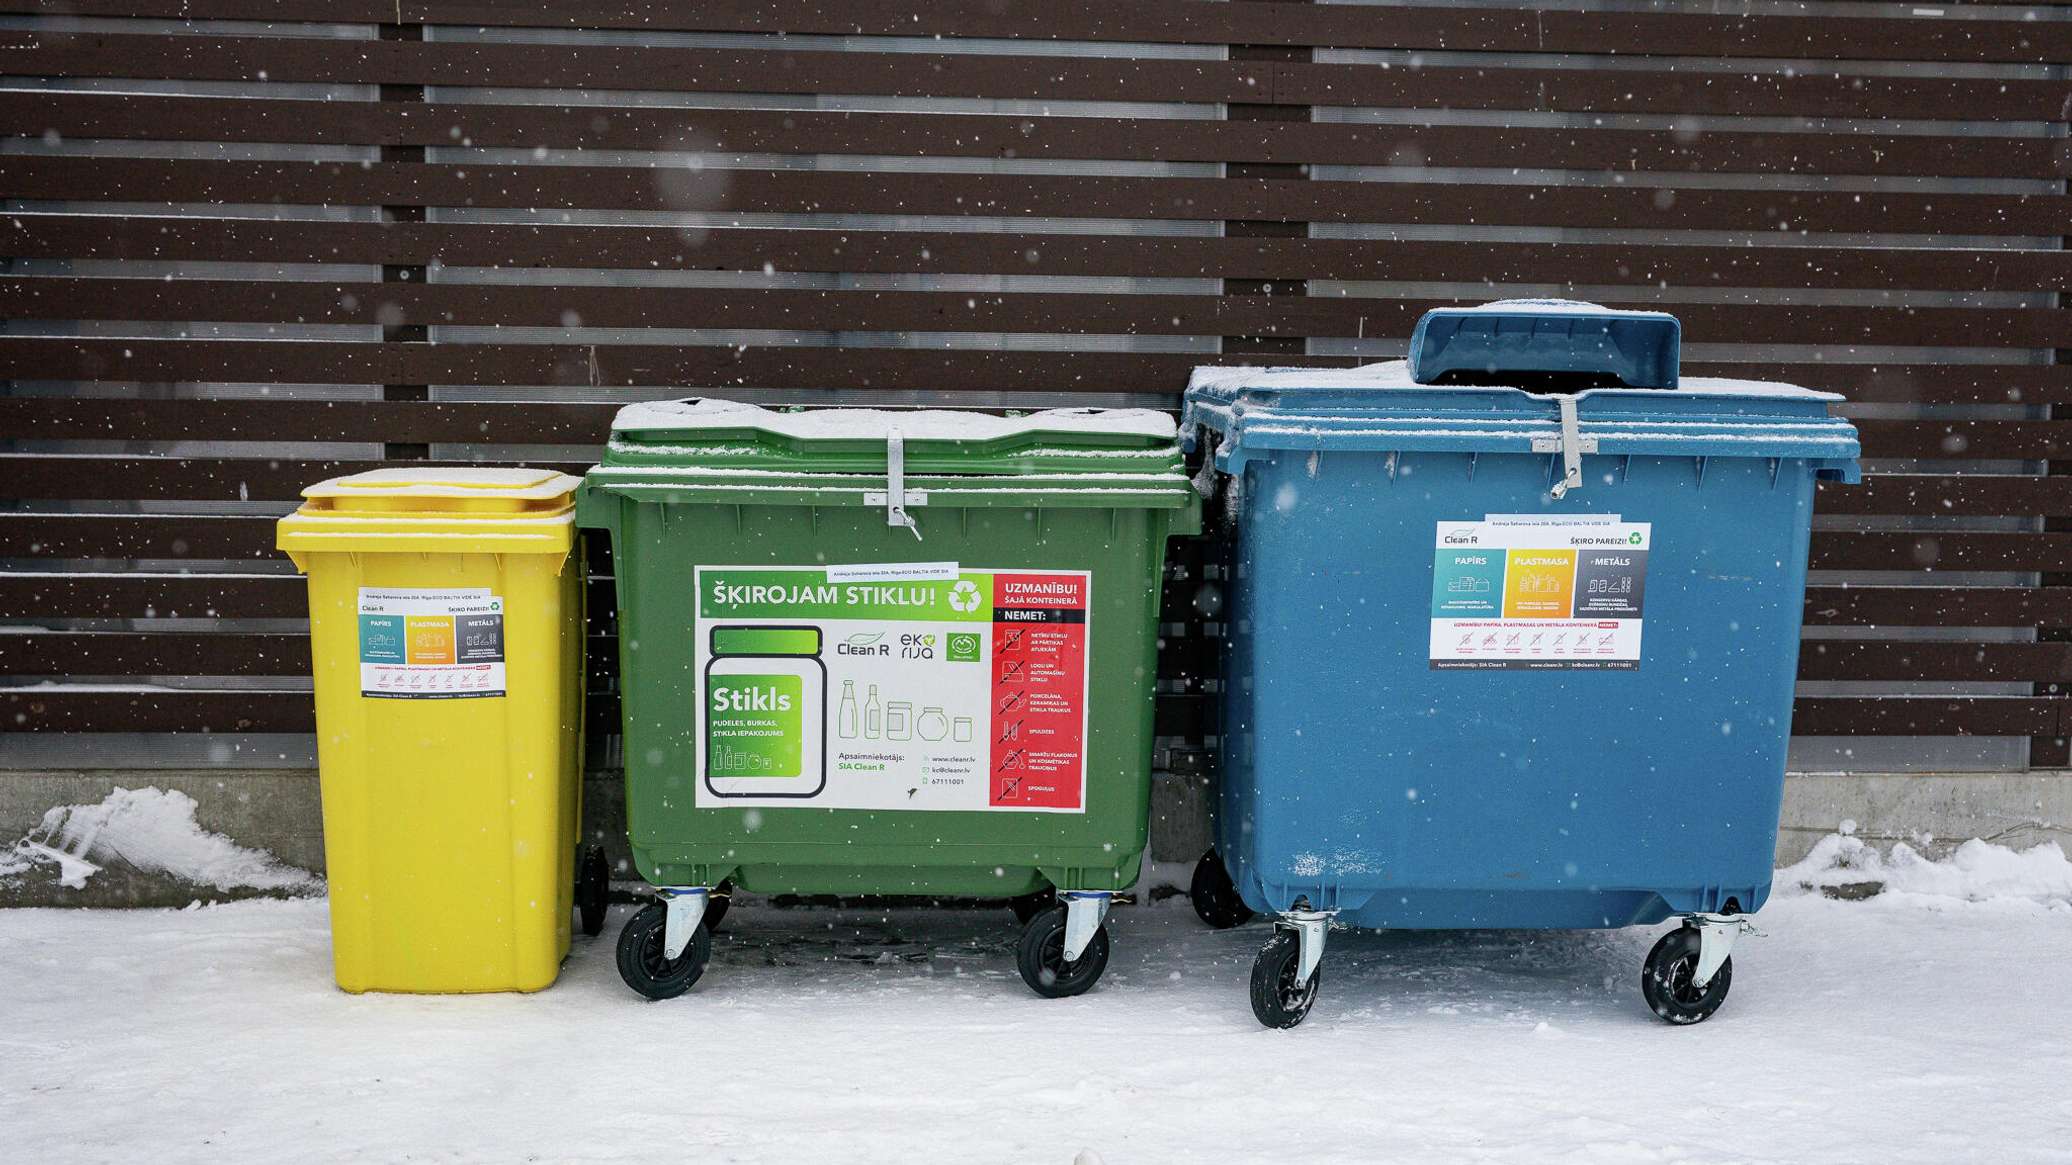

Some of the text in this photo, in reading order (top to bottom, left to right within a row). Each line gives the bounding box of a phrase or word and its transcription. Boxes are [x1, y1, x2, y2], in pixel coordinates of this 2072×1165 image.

[1444, 535, 1478, 544] Clean R
[1570, 537, 1627, 546] ŠĶIRO PAREIZI!
[1455, 556, 1487, 565] PAPĪRS
[1515, 557, 1568, 566] PLASTMASA
[1595, 556, 1631, 566] METĀLS
[1005, 581, 1078, 594] UZMANĪBU!
[713, 580, 935, 609] ŠĶIROJAM STIKLU!
[1004, 595, 1078, 605] ŠAJĀ KONTEINERĀ
[1004, 610, 1047, 621] NEMET:
[467, 619, 494, 627] METĀLS
[837, 643, 890, 656] Clean R
[901, 647, 934, 660] rija
[713, 686, 792, 712] Stikls
[838, 752, 905, 763] Apsaimniekotājs:
[838, 762, 885, 771] SIA Clean R
